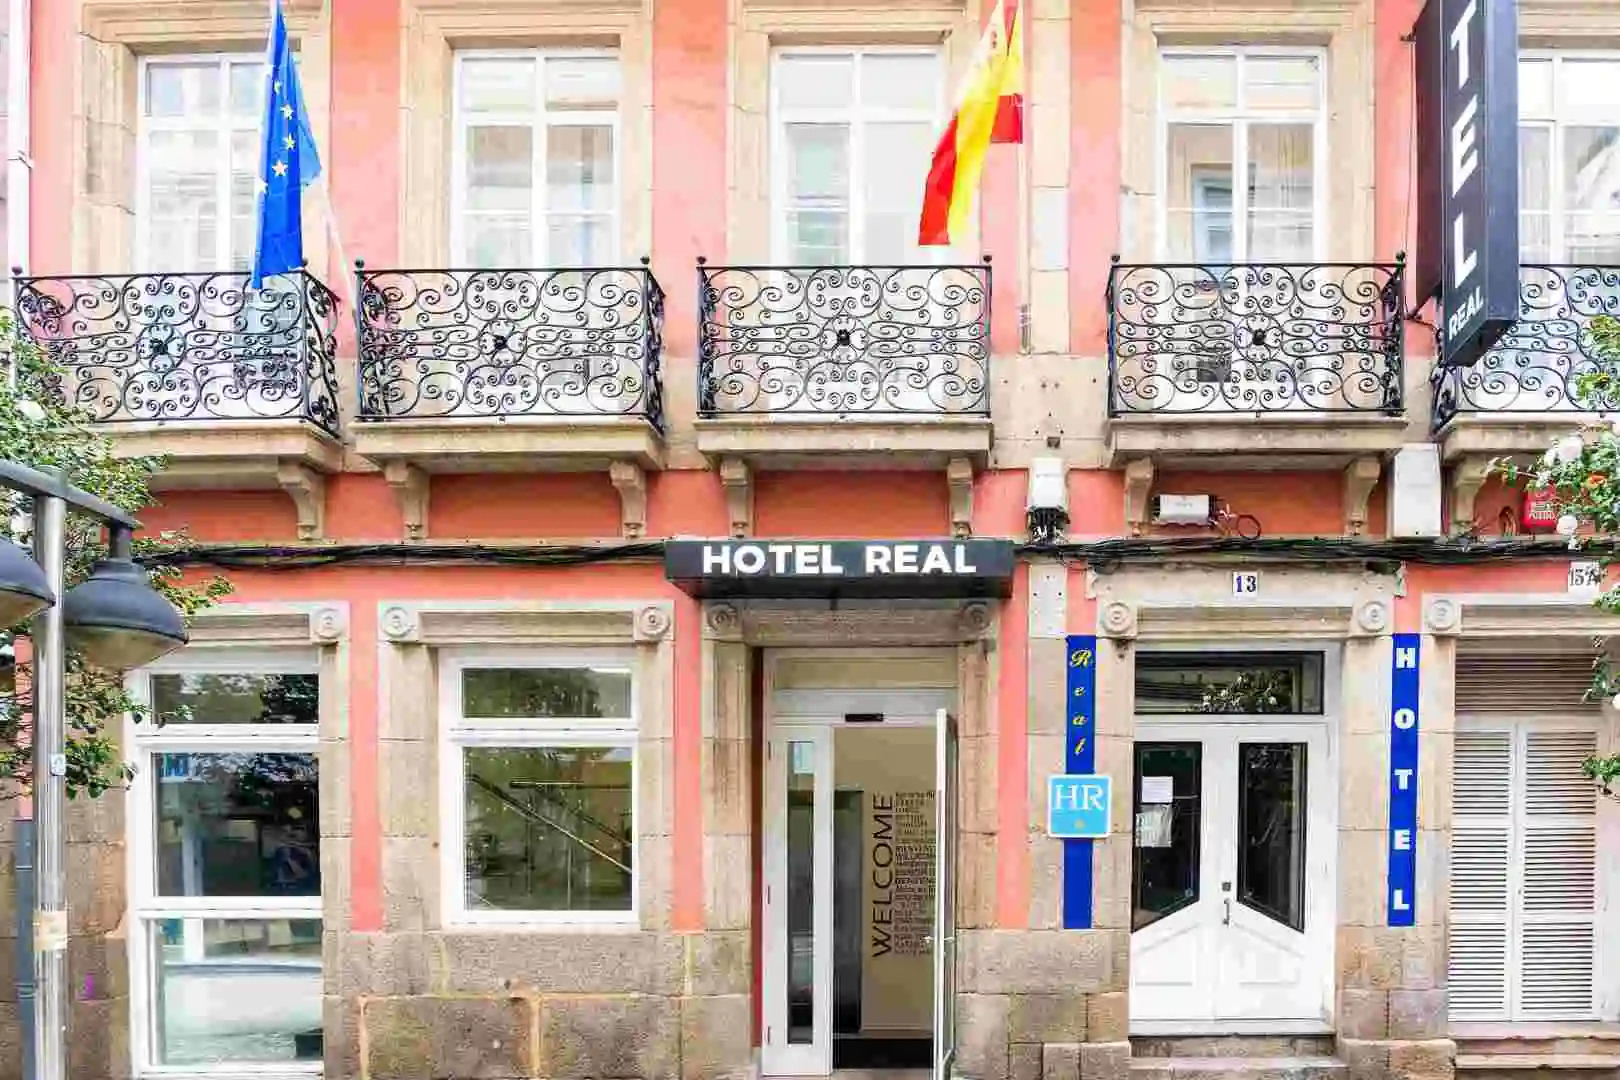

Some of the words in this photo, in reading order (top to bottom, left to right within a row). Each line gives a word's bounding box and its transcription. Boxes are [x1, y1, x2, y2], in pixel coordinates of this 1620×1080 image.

[1448, 286, 1484, 341] REAL
[703, 545, 844, 574] HOTEL
[865, 545, 977, 574] REAL
[1236, 575, 1257, 593] 13
[1069, 649, 1093, 756] Real
[1053, 784, 1106, 811] HR
[1393, 647, 1416, 911] HOTEL
[872, 793, 894, 958] WELCOME
